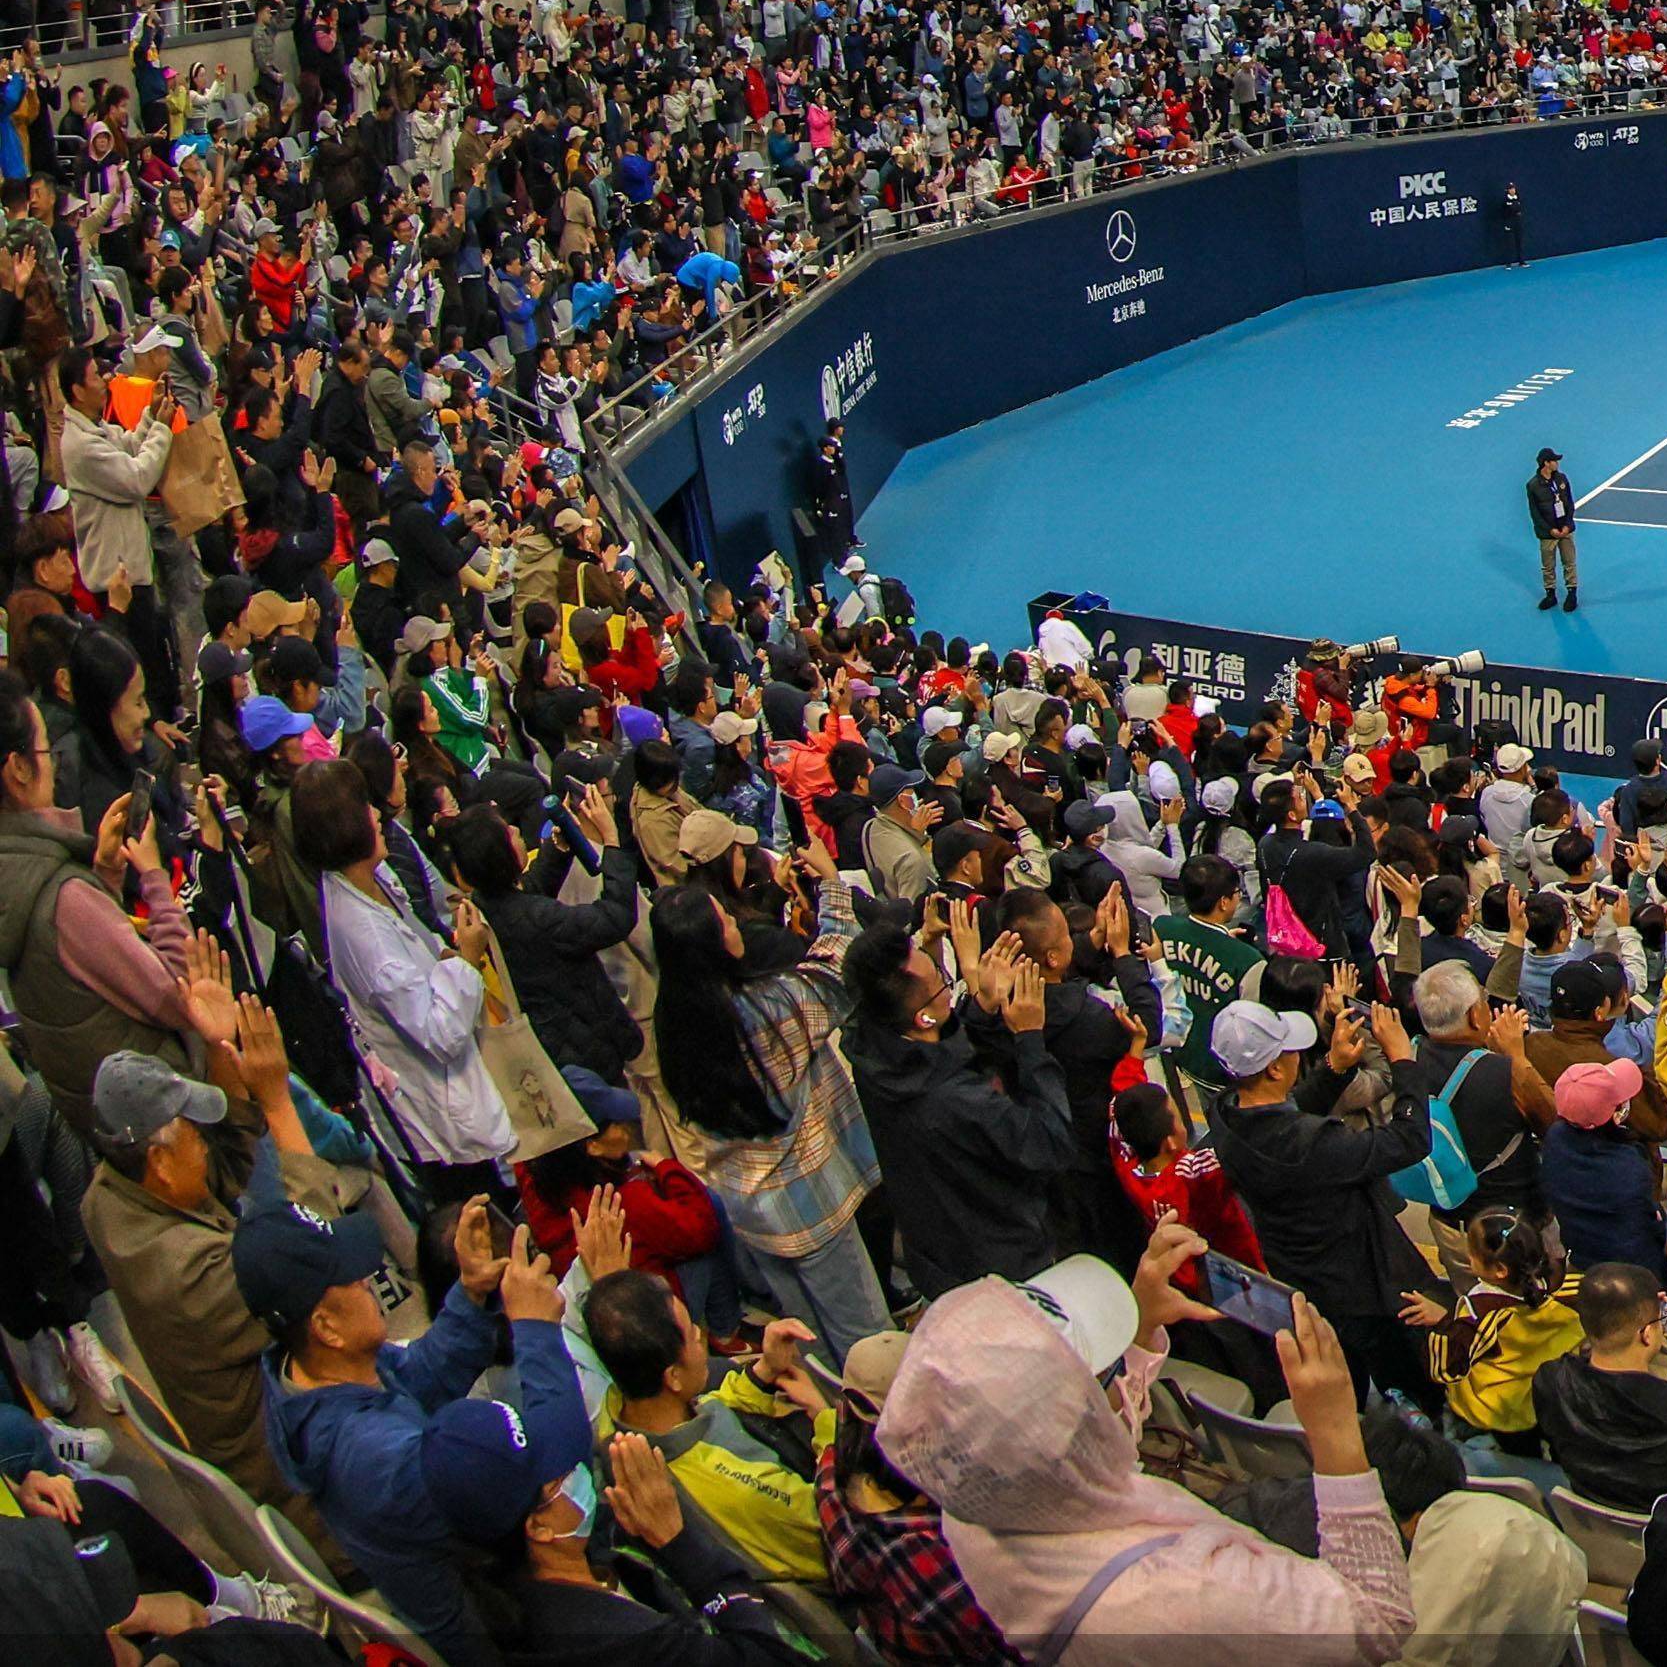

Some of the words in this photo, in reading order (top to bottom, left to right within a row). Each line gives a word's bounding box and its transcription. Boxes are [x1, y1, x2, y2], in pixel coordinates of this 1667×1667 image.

[1588, 132, 1604, 140] WTA
[1589, 139, 1604, 147] 1000
[1612, 126, 1639, 141] ATP
[1627, 136, 1639, 145] 500
[1400, 170, 1446, 198] PICC
[1369, 196, 1478, 227] 中国人民保险
[1086, 263, 1164, 304] Mercedes-Benz
[1112, 300, 1146, 325] 北京奔驰
[837, 331, 873, 395] 中信银行
[1484, 368, 1576, 408] BEIJING
[1446, 404, 1498, 430] 北京
[1151, 643, 1245, 685] 利亚德
[1162, 940, 1235, 992] EKING
[1181, 974, 1219, 1004] NIU.
